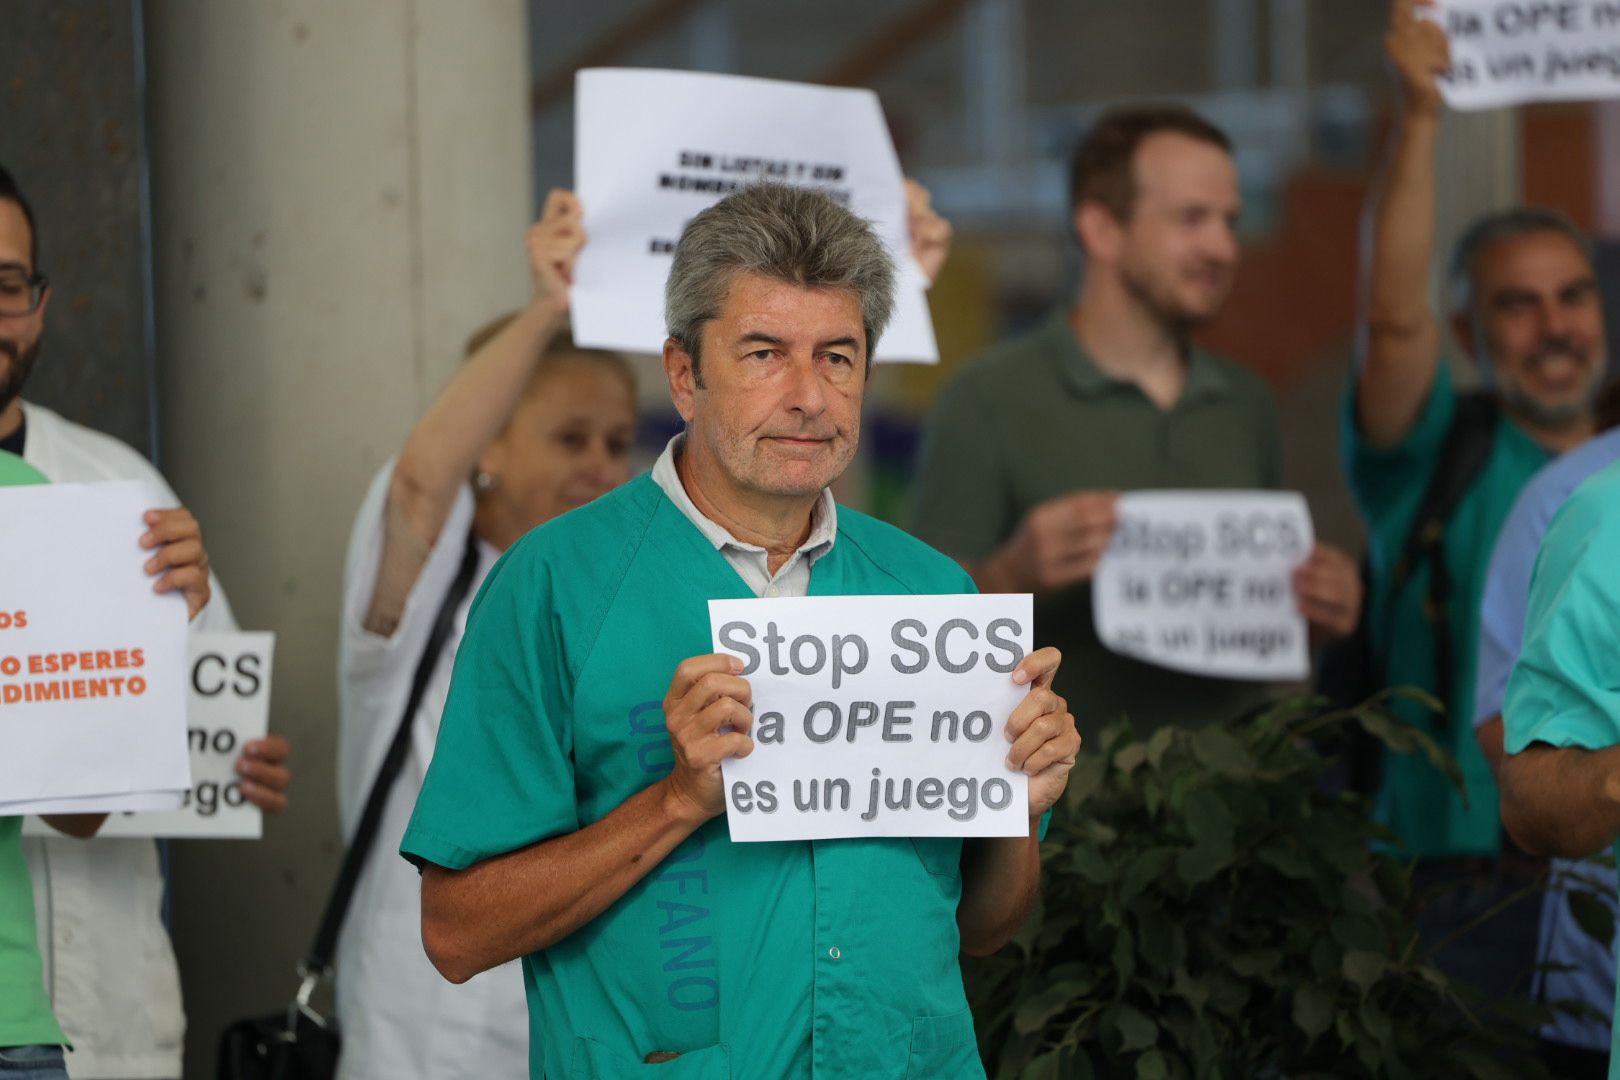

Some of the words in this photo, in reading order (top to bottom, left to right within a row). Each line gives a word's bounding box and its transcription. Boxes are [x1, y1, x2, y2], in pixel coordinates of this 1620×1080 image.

[1495, 2, 1582, 36] OPE
[1487, 53, 1535, 81] un
[1160, 571, 1234, 606] OPE
[718, 620, 869, 690] Stop
[890, 618, 1025, 675] SCS
[1205, 622, 1294, 659] juego
[28, 648, 145, 675] ESPERES
[0, 675, 147, 705] DIMIENTO
[750, 702, 785, 745] a
[802, 700, 916, 744] OPE
[930, 710, 993, 743] no
[731, 781, 779, 814] es
[793, 777, 852, 812] un
[860, 767, 1014, 822] juego
